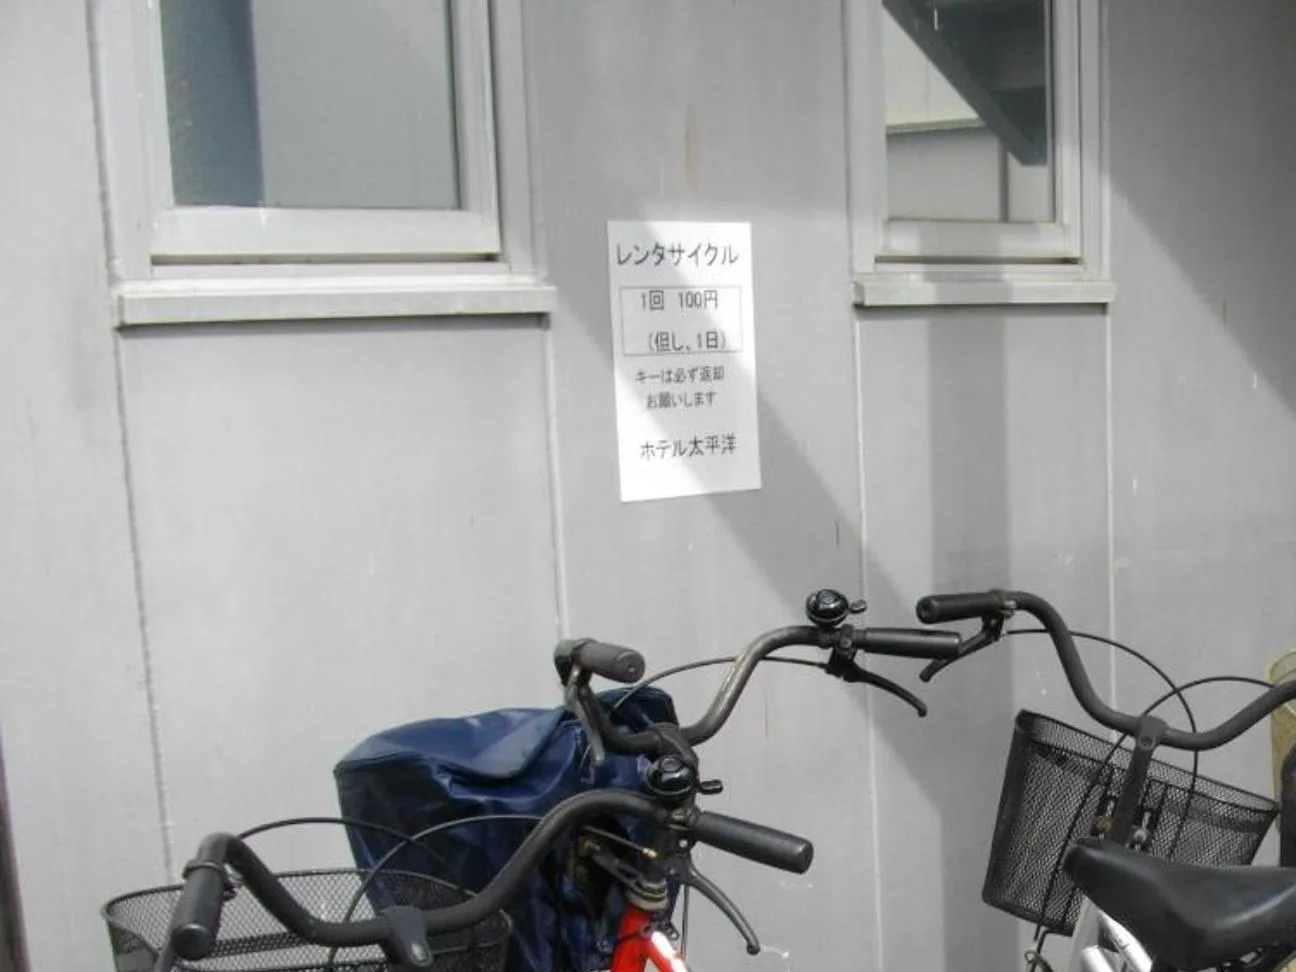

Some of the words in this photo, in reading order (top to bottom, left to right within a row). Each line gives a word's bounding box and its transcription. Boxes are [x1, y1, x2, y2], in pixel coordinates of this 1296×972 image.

[616, 243, 740, 266] レンタサイクル
[641, 290, 665, 311] 1回
[678, 289, 719, 310] 100円
[635, 365, 726, 385] キーは必ず返却
[647, 391, 717, 411] お願いします
[639, 433, 738, 460] ホテル太平洋
